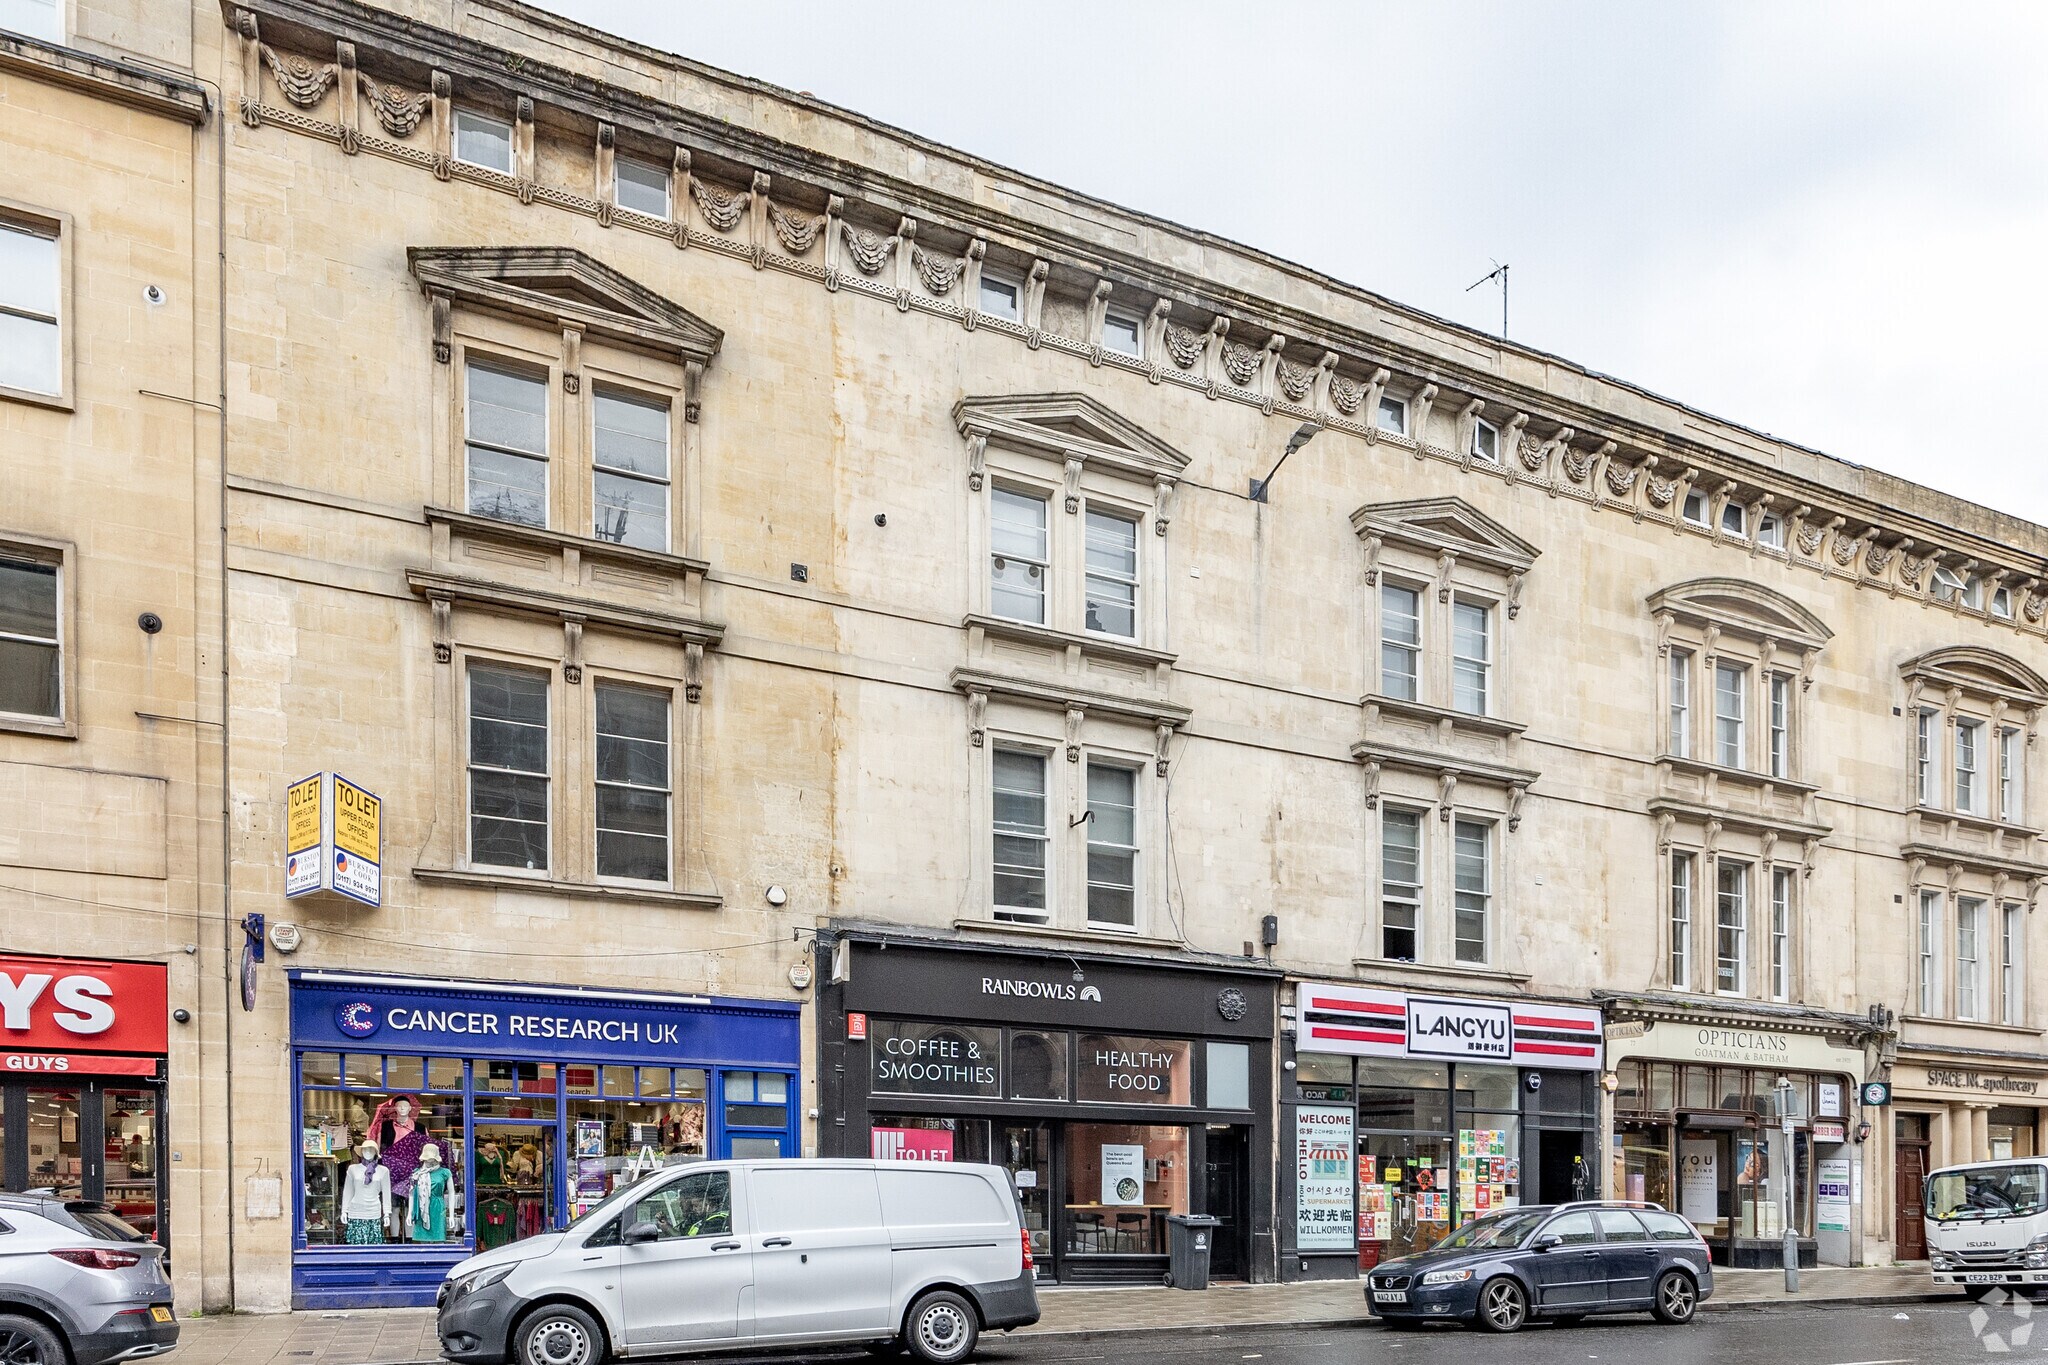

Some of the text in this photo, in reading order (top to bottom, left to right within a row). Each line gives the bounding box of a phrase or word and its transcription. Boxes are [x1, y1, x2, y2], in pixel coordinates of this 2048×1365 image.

[290, 780, 318, 808] TO LET
[338, 782, 377, 818] TO LET
[340, 807, 375, 831] UPPER FLOOR
[347, 822, 368, 839] OFFICES
[354, 869, 372, 882] COOK
[982, 977, 1076, 1001] RAINBOWLS
[387, 1008, 679, 1045] CANCER RESEARCH UK
[1415, 1013, 1505, 1040] LANGYU
[1606, 1024, 1643, 1037] OPTICIANS
[886, 1038, 981, 1060] COFFEE &
[1697, 1029, 1787, 1052] OPTICIANS
[6, 1055, 69, 1071] GUYS
[1096, 1050, 1174, 1070] HEALTHY
[1695, 1048, 1789, 1064] GOATMAN & BATHAM
[878, 1060, 995, 1084] SMOOTHIES
[428, 1082, 456, 1091] Everyth
[567, 1088, 591, 1096] search
[1108, 1073, 1161, 1092] FOOD
[1298, 1114, 1351, 1125] WELCOME
[1813, 1126, 1830, 1137] ARBER
[896, 1149, 917, 1160] TO
[1298, 1139, 1307, 1180] HELLO
[1681, 1155, 1713, 1166] YOU
[253, 1157, 269, 1173] 71
[1298, 1208, 1352, 1222] 欢迎光临
[1300, 1225, 1353, 1234] WILLKOMMEN
